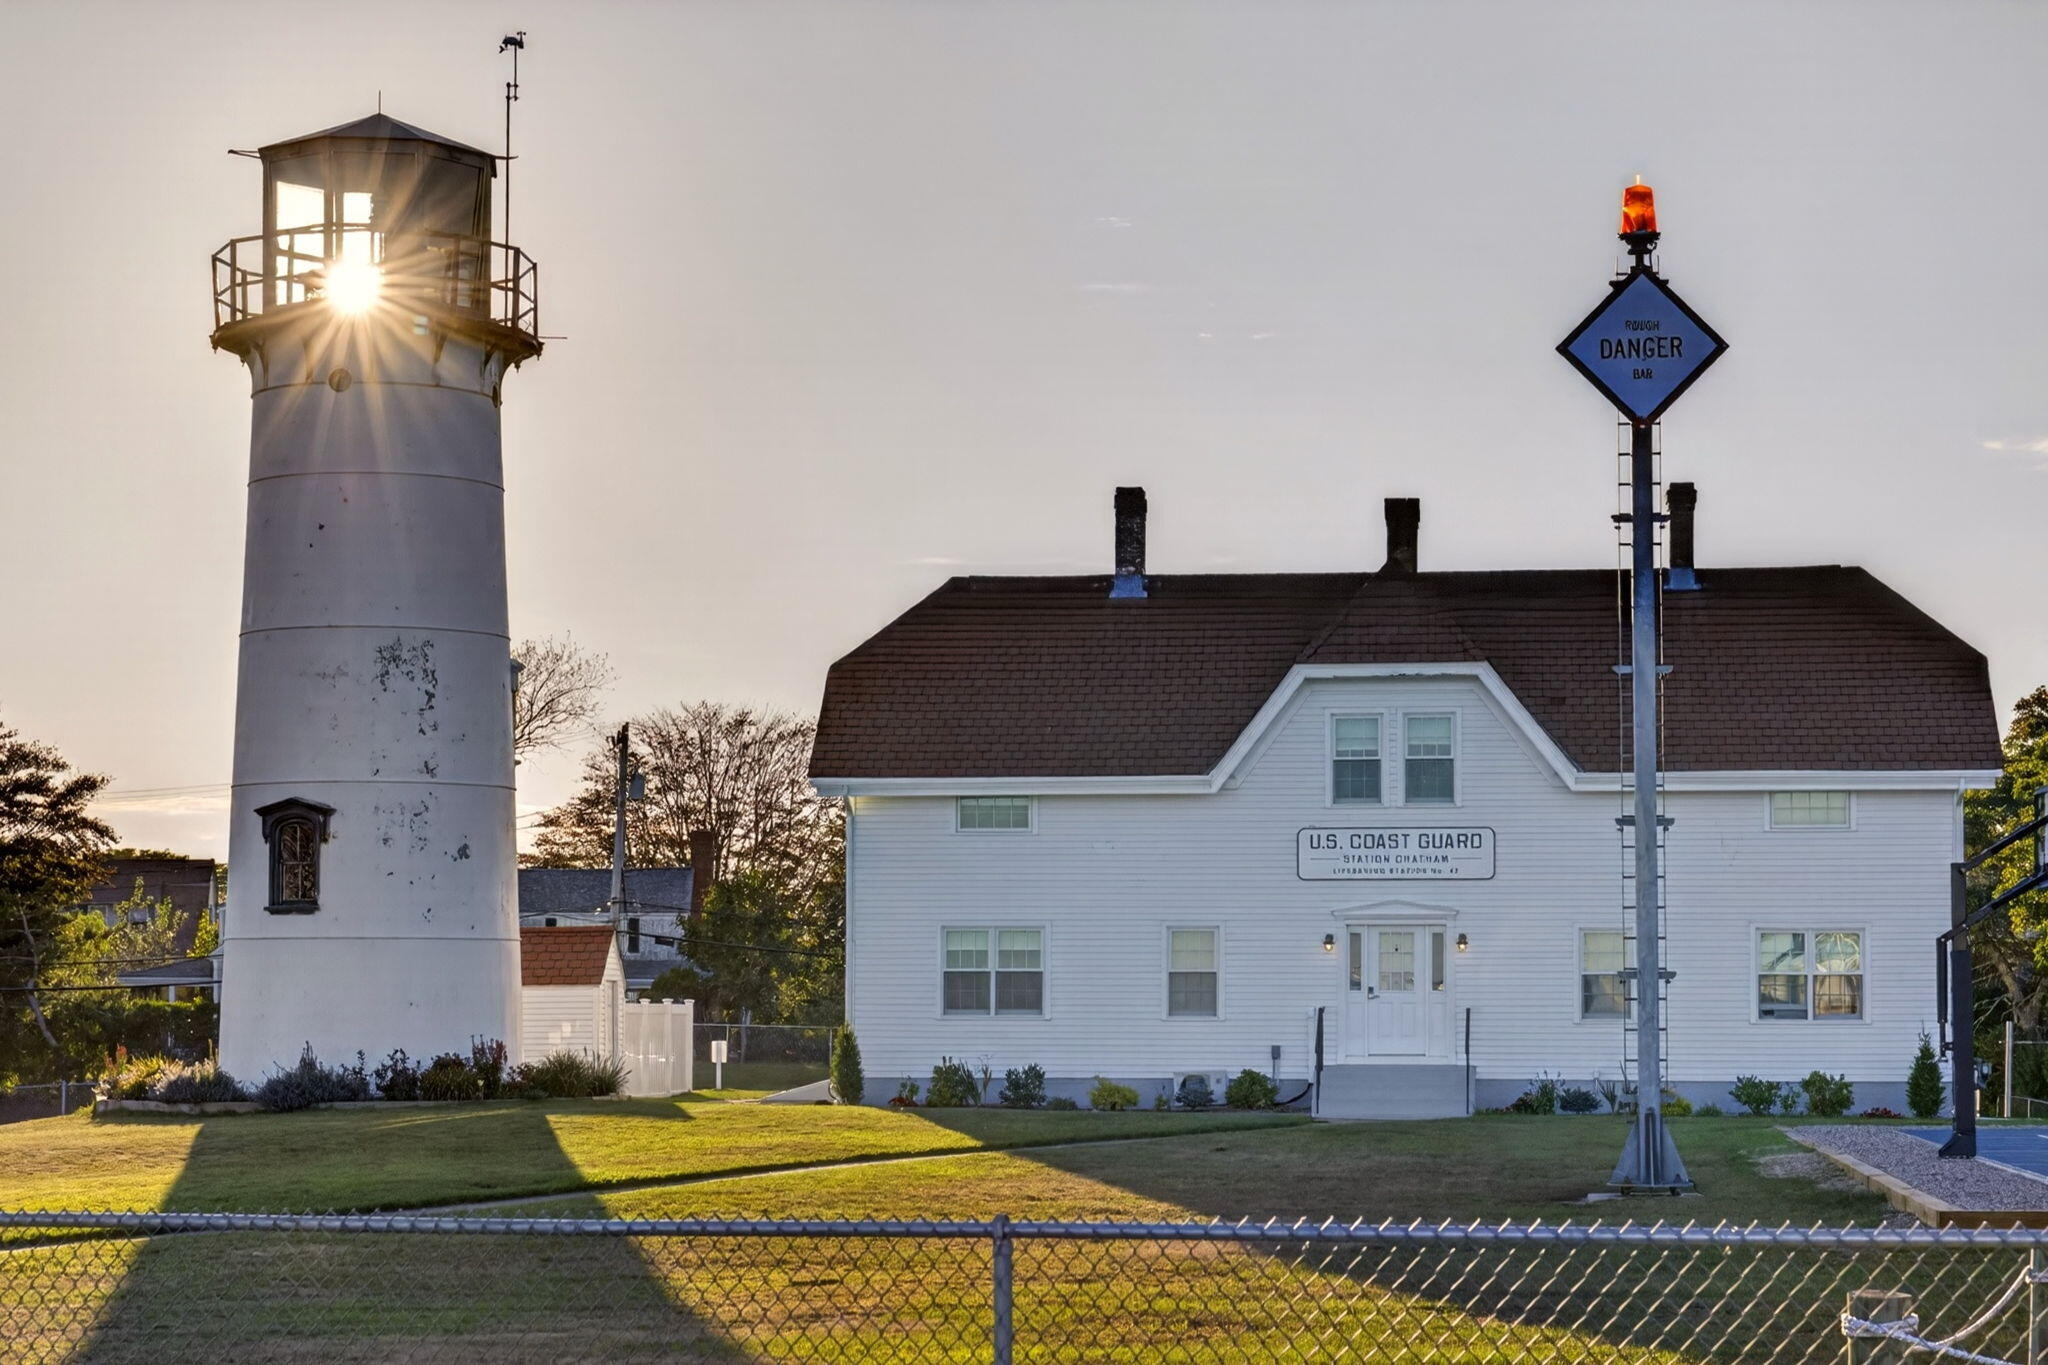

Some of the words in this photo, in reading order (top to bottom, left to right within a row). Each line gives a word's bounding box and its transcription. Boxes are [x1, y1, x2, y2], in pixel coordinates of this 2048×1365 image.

[1624, 319, 1660, 332] ROUGH
[1600, 336, 1684, 360] DANGER
[1633, 368, 1653, 380] BAR
[1309, 833, 1344, 850] U.S.
[1350, 833, 1411, 850] COAST
[1418, 833, 1483, 850] GUARD
[1343, 854, 1390, 864] STATION
[1395, 854, 1450, 864] CHATHAM
